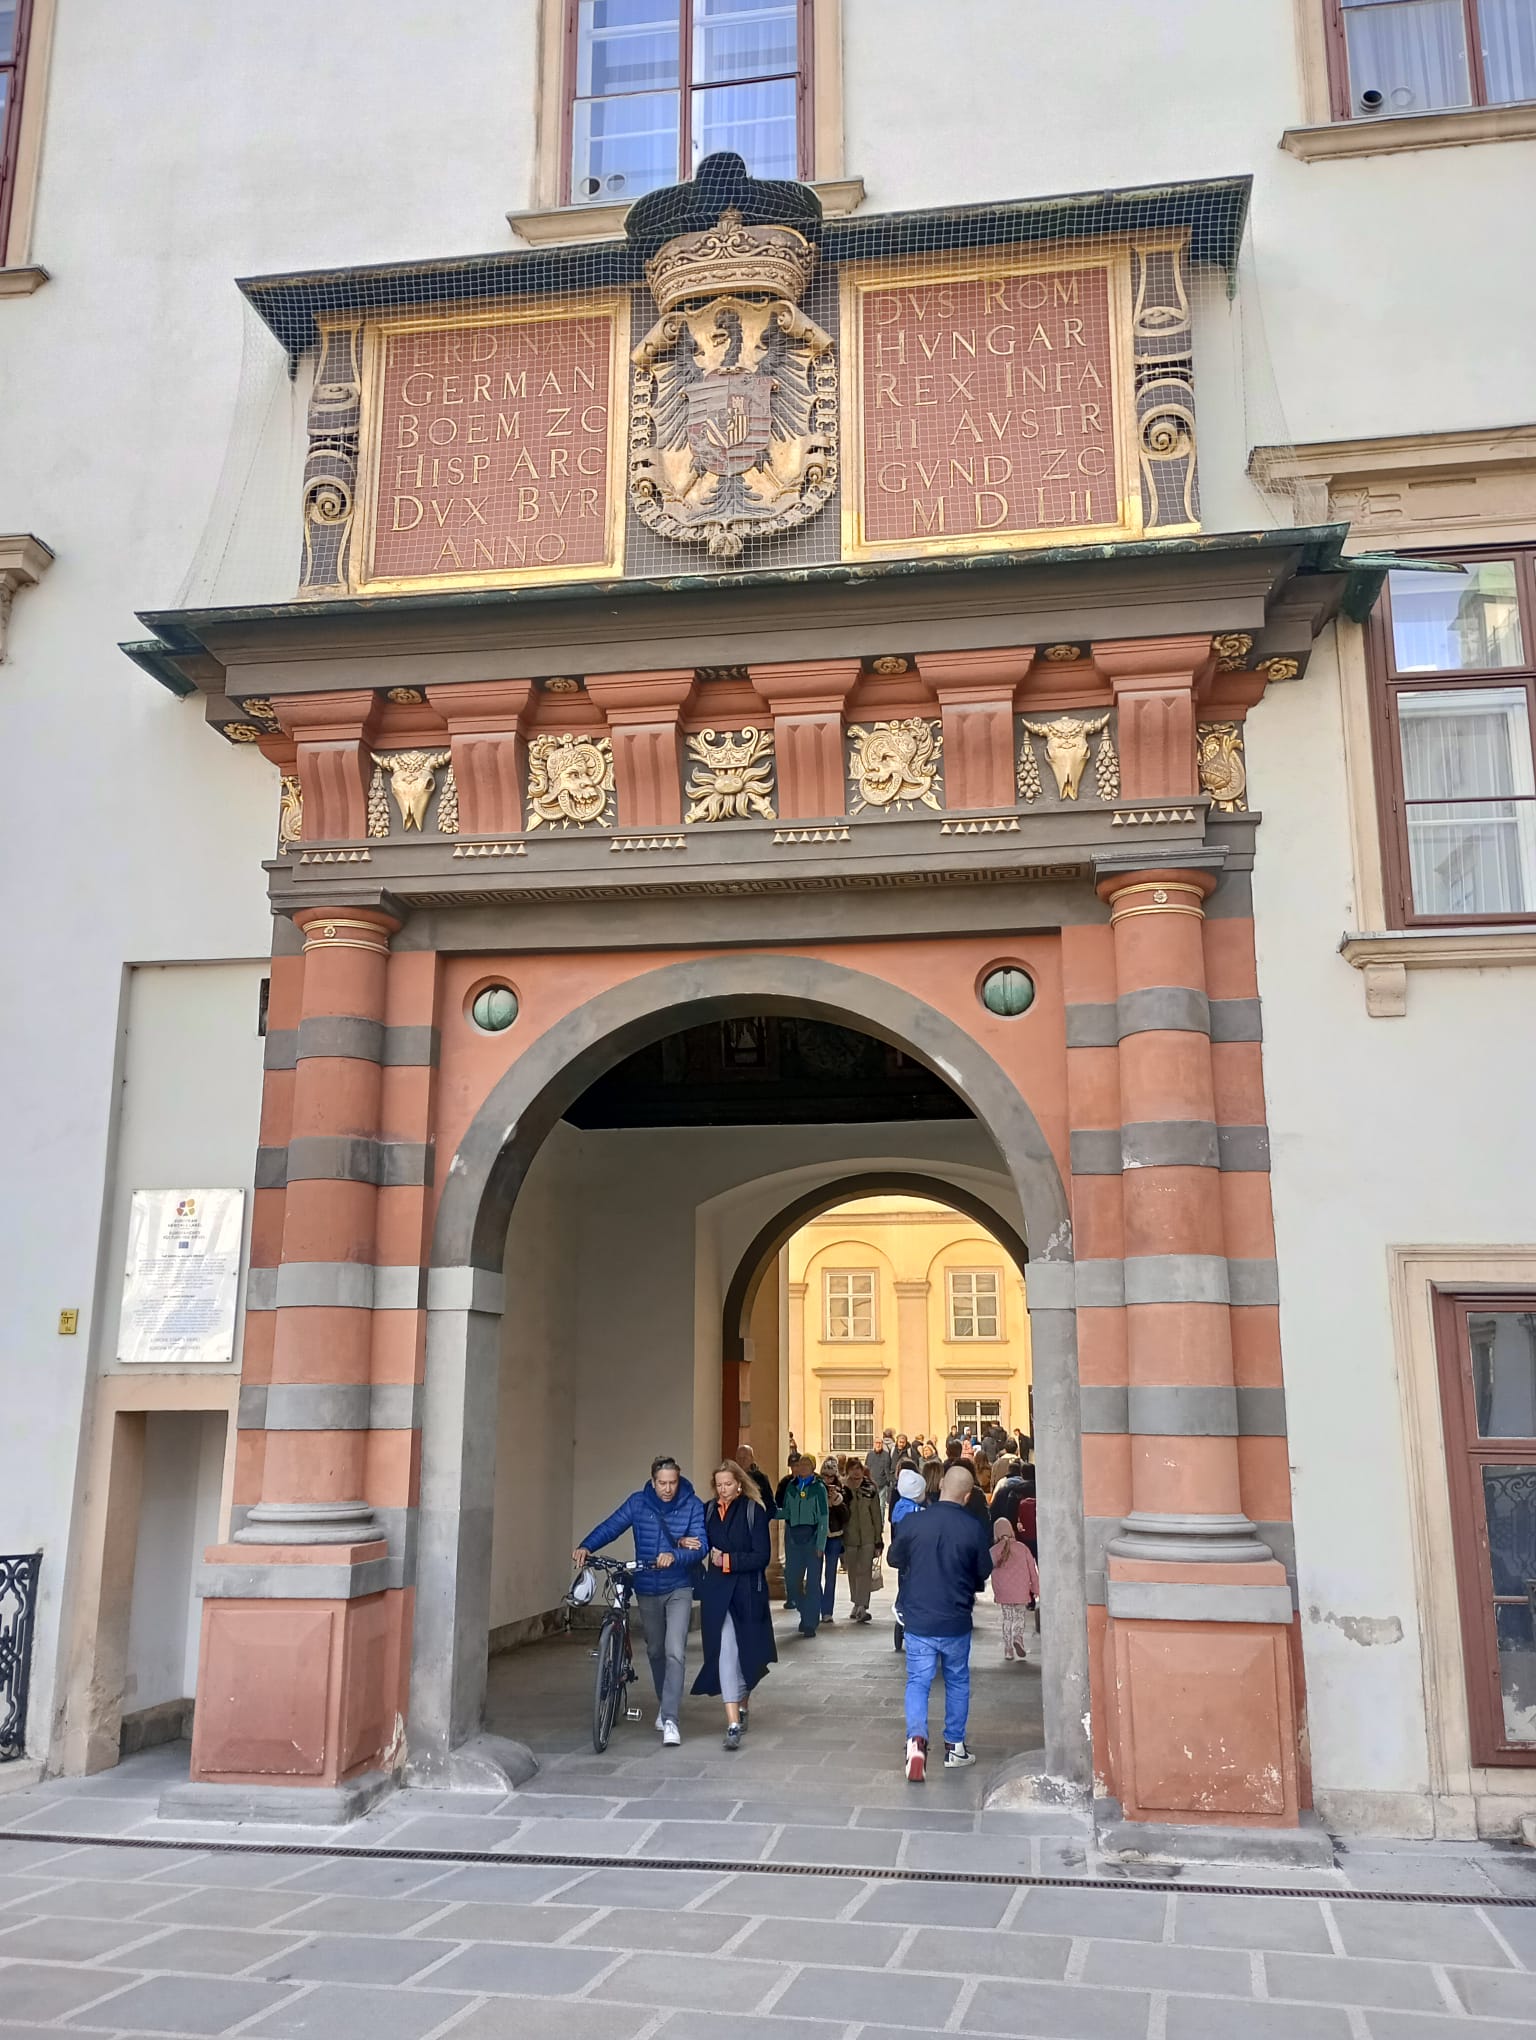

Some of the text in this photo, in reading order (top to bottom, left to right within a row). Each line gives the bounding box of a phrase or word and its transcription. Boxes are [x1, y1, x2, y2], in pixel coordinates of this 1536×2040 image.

[874, 277, 1080, 326] DVS ROM
[875, 318, 1087, 368] HVNGAR
[401, 365, 596, 407] GERMAN
[875, 360, 1105, 409] REX INFA
[396, 411, 522, 449] BOEM
[876, 402, 1105, 452] HI AVSTR
[395, 446, 603, 490] HISP ARC
[877, 455, 1013, 494] GVND
[390, 486, 601, 532] DVX BVR
[432, 533, 567, 571] ANNO
